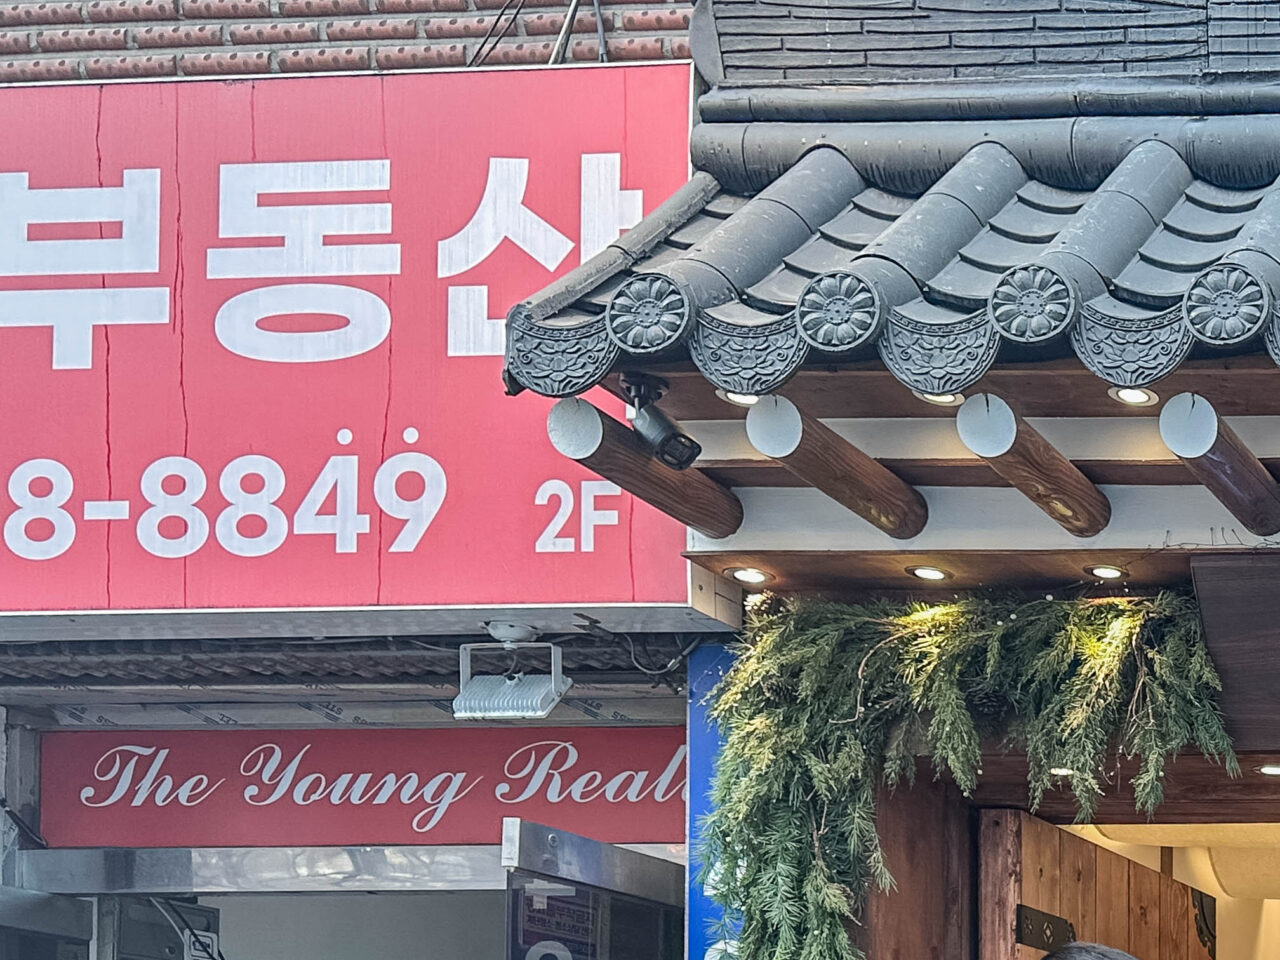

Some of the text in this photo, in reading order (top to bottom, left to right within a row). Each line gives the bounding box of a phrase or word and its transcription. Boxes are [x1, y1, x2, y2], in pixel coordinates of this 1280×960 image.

[0, 152, 643, 370] 부동산
[535, 479, 622, 554] 2F
[80, 740, 687, 832] The Young Real
